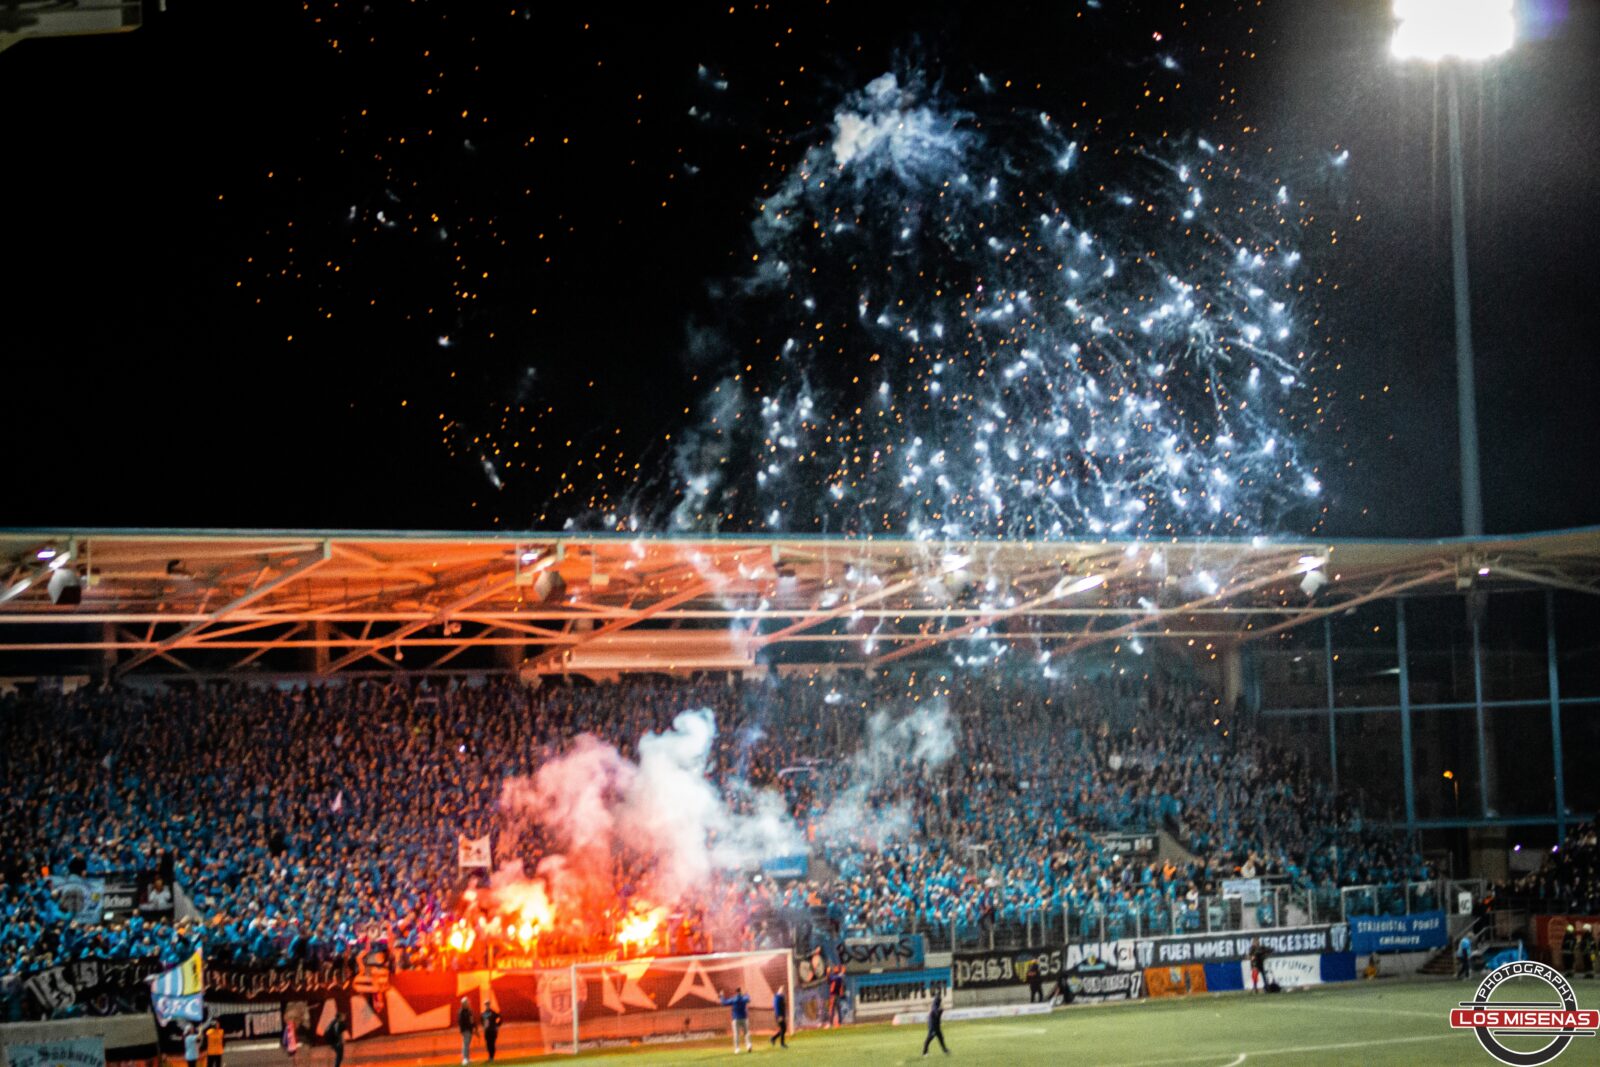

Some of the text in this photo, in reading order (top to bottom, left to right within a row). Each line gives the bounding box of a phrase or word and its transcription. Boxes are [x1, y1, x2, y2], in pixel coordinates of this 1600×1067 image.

[1159, 931, 1327, 962] FUER IMMER UNERGESSEN
